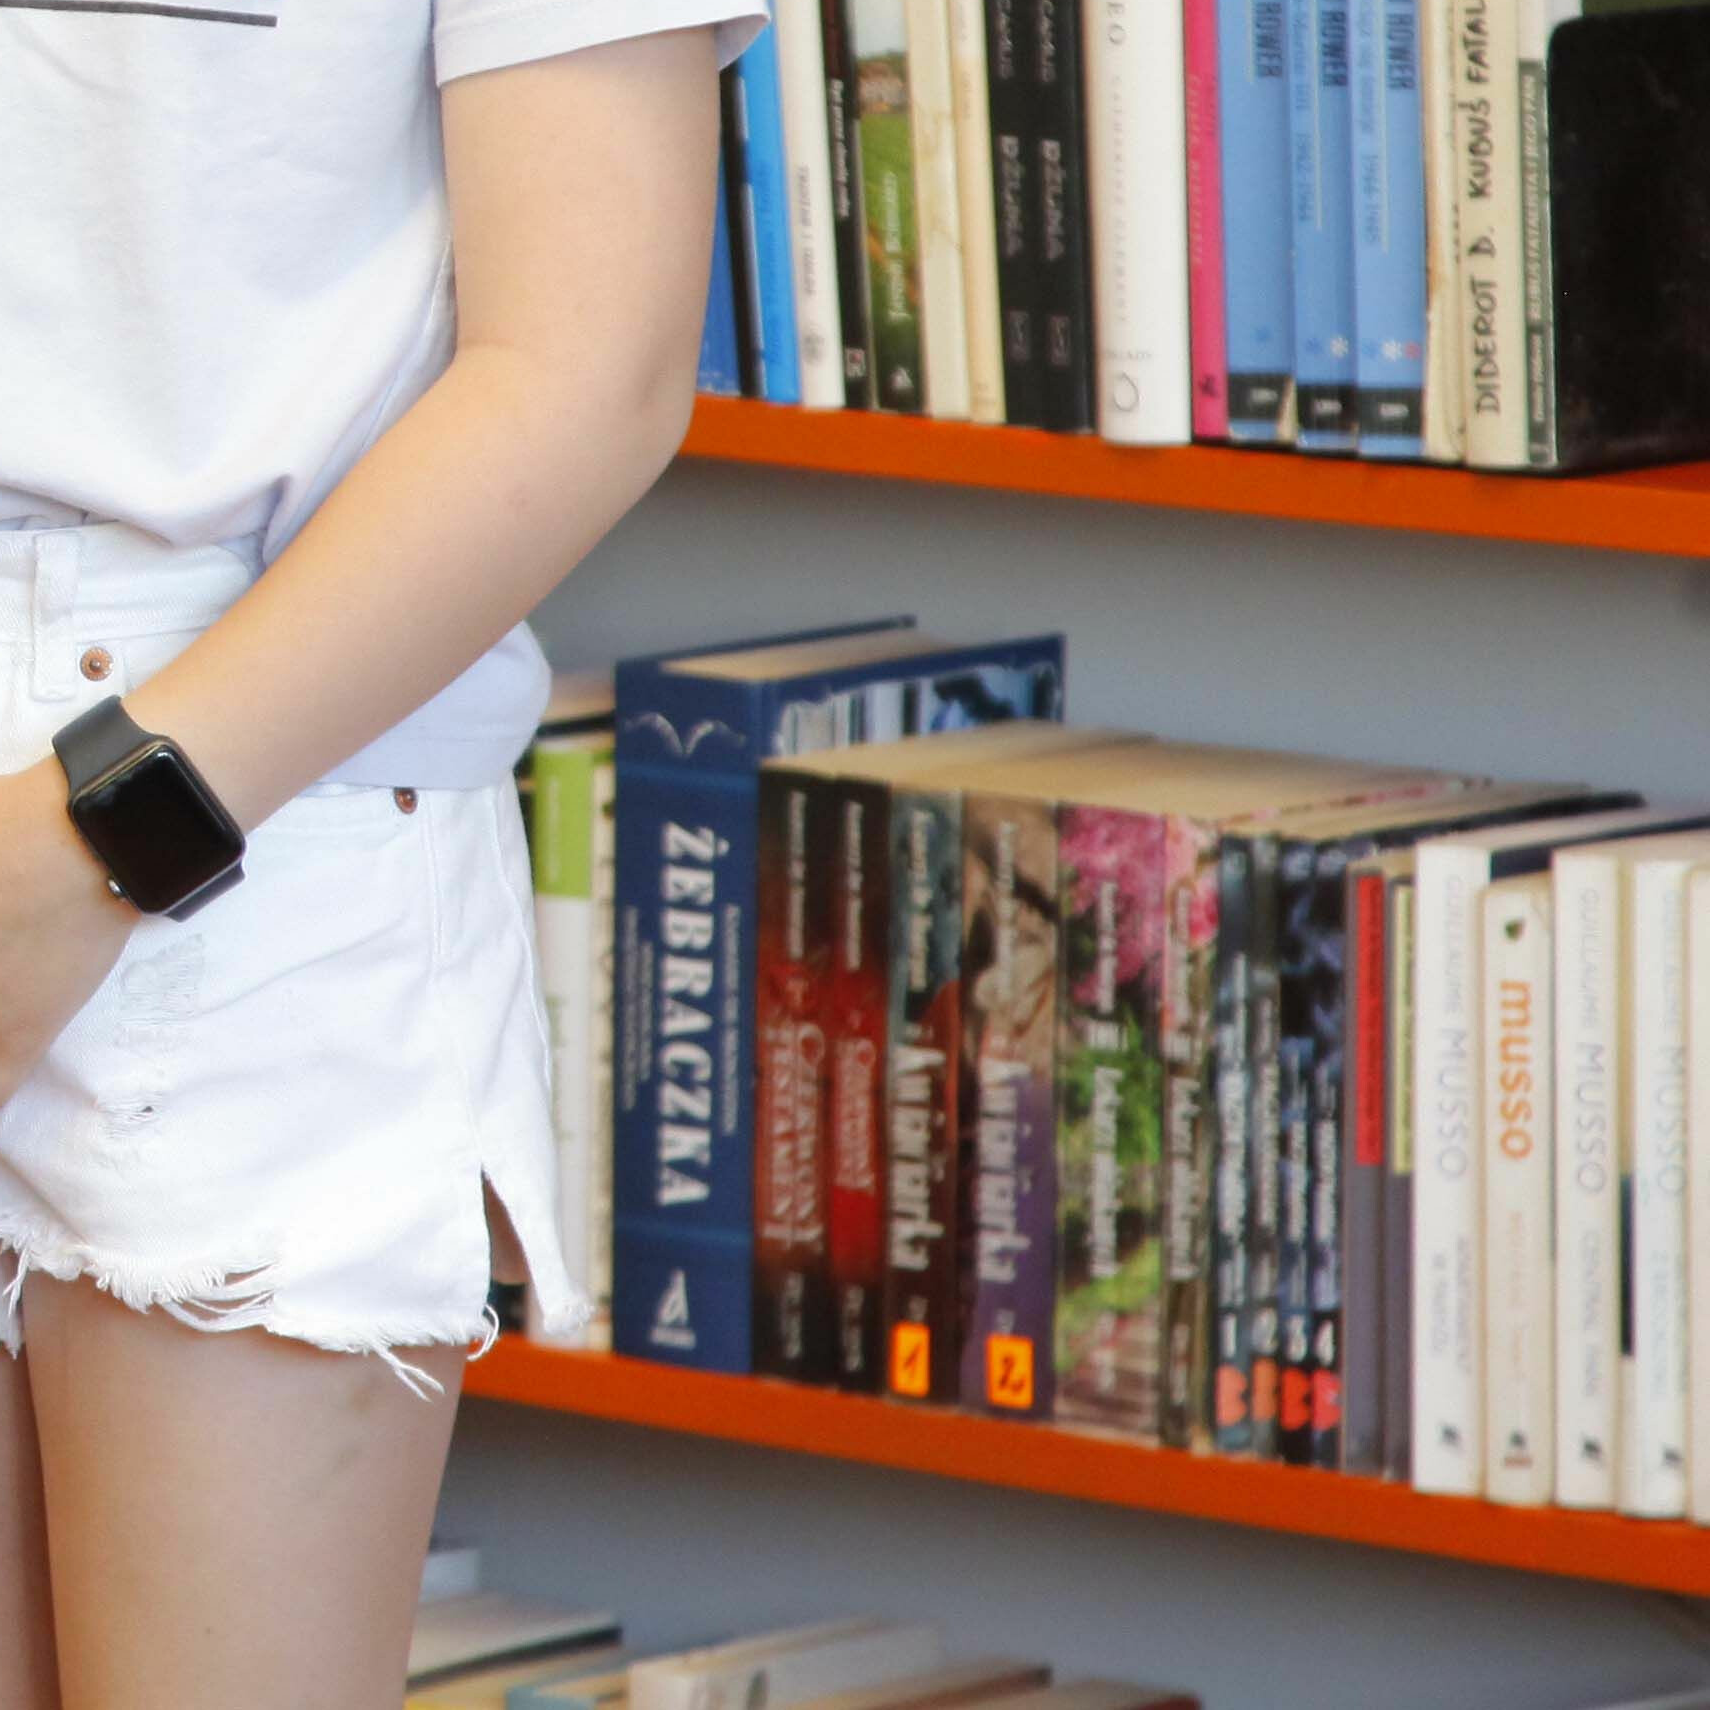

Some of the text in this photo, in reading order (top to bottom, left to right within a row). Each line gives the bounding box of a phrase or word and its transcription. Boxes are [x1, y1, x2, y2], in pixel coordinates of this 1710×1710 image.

[1252, 1, 1283, 80] ROWER
[1319, 9, 1349, 89] ROWER
[1387, 12, 1417, 91] ROWER
[997, 135, 1027, 259] DŻUMA
[1039, 139, 1068, 263] DŻUMA
[1460, 99, 1496, 198] KUBUŚ
[1467, 277, 1502, 416] DIDEROT
[656, 822, 731, 1208] ŻEBRACZKA
[1435, 874, 1469, 1183] GUILLAUME MUSSO
[1575, 889, 1600, 1029] GUILLAUME
[761, 1027, 795, 1239] TESTAMENT
[793, 1022, 825, 1248] CZERWONY
[852, 1038, 878, 1195] CZERWONY
[1497, 979, 1534, 1161] musso
[1573, 1041, 1606, 1196] MUSSO
[1654, 1044, 1688, 1199] MUSSO
